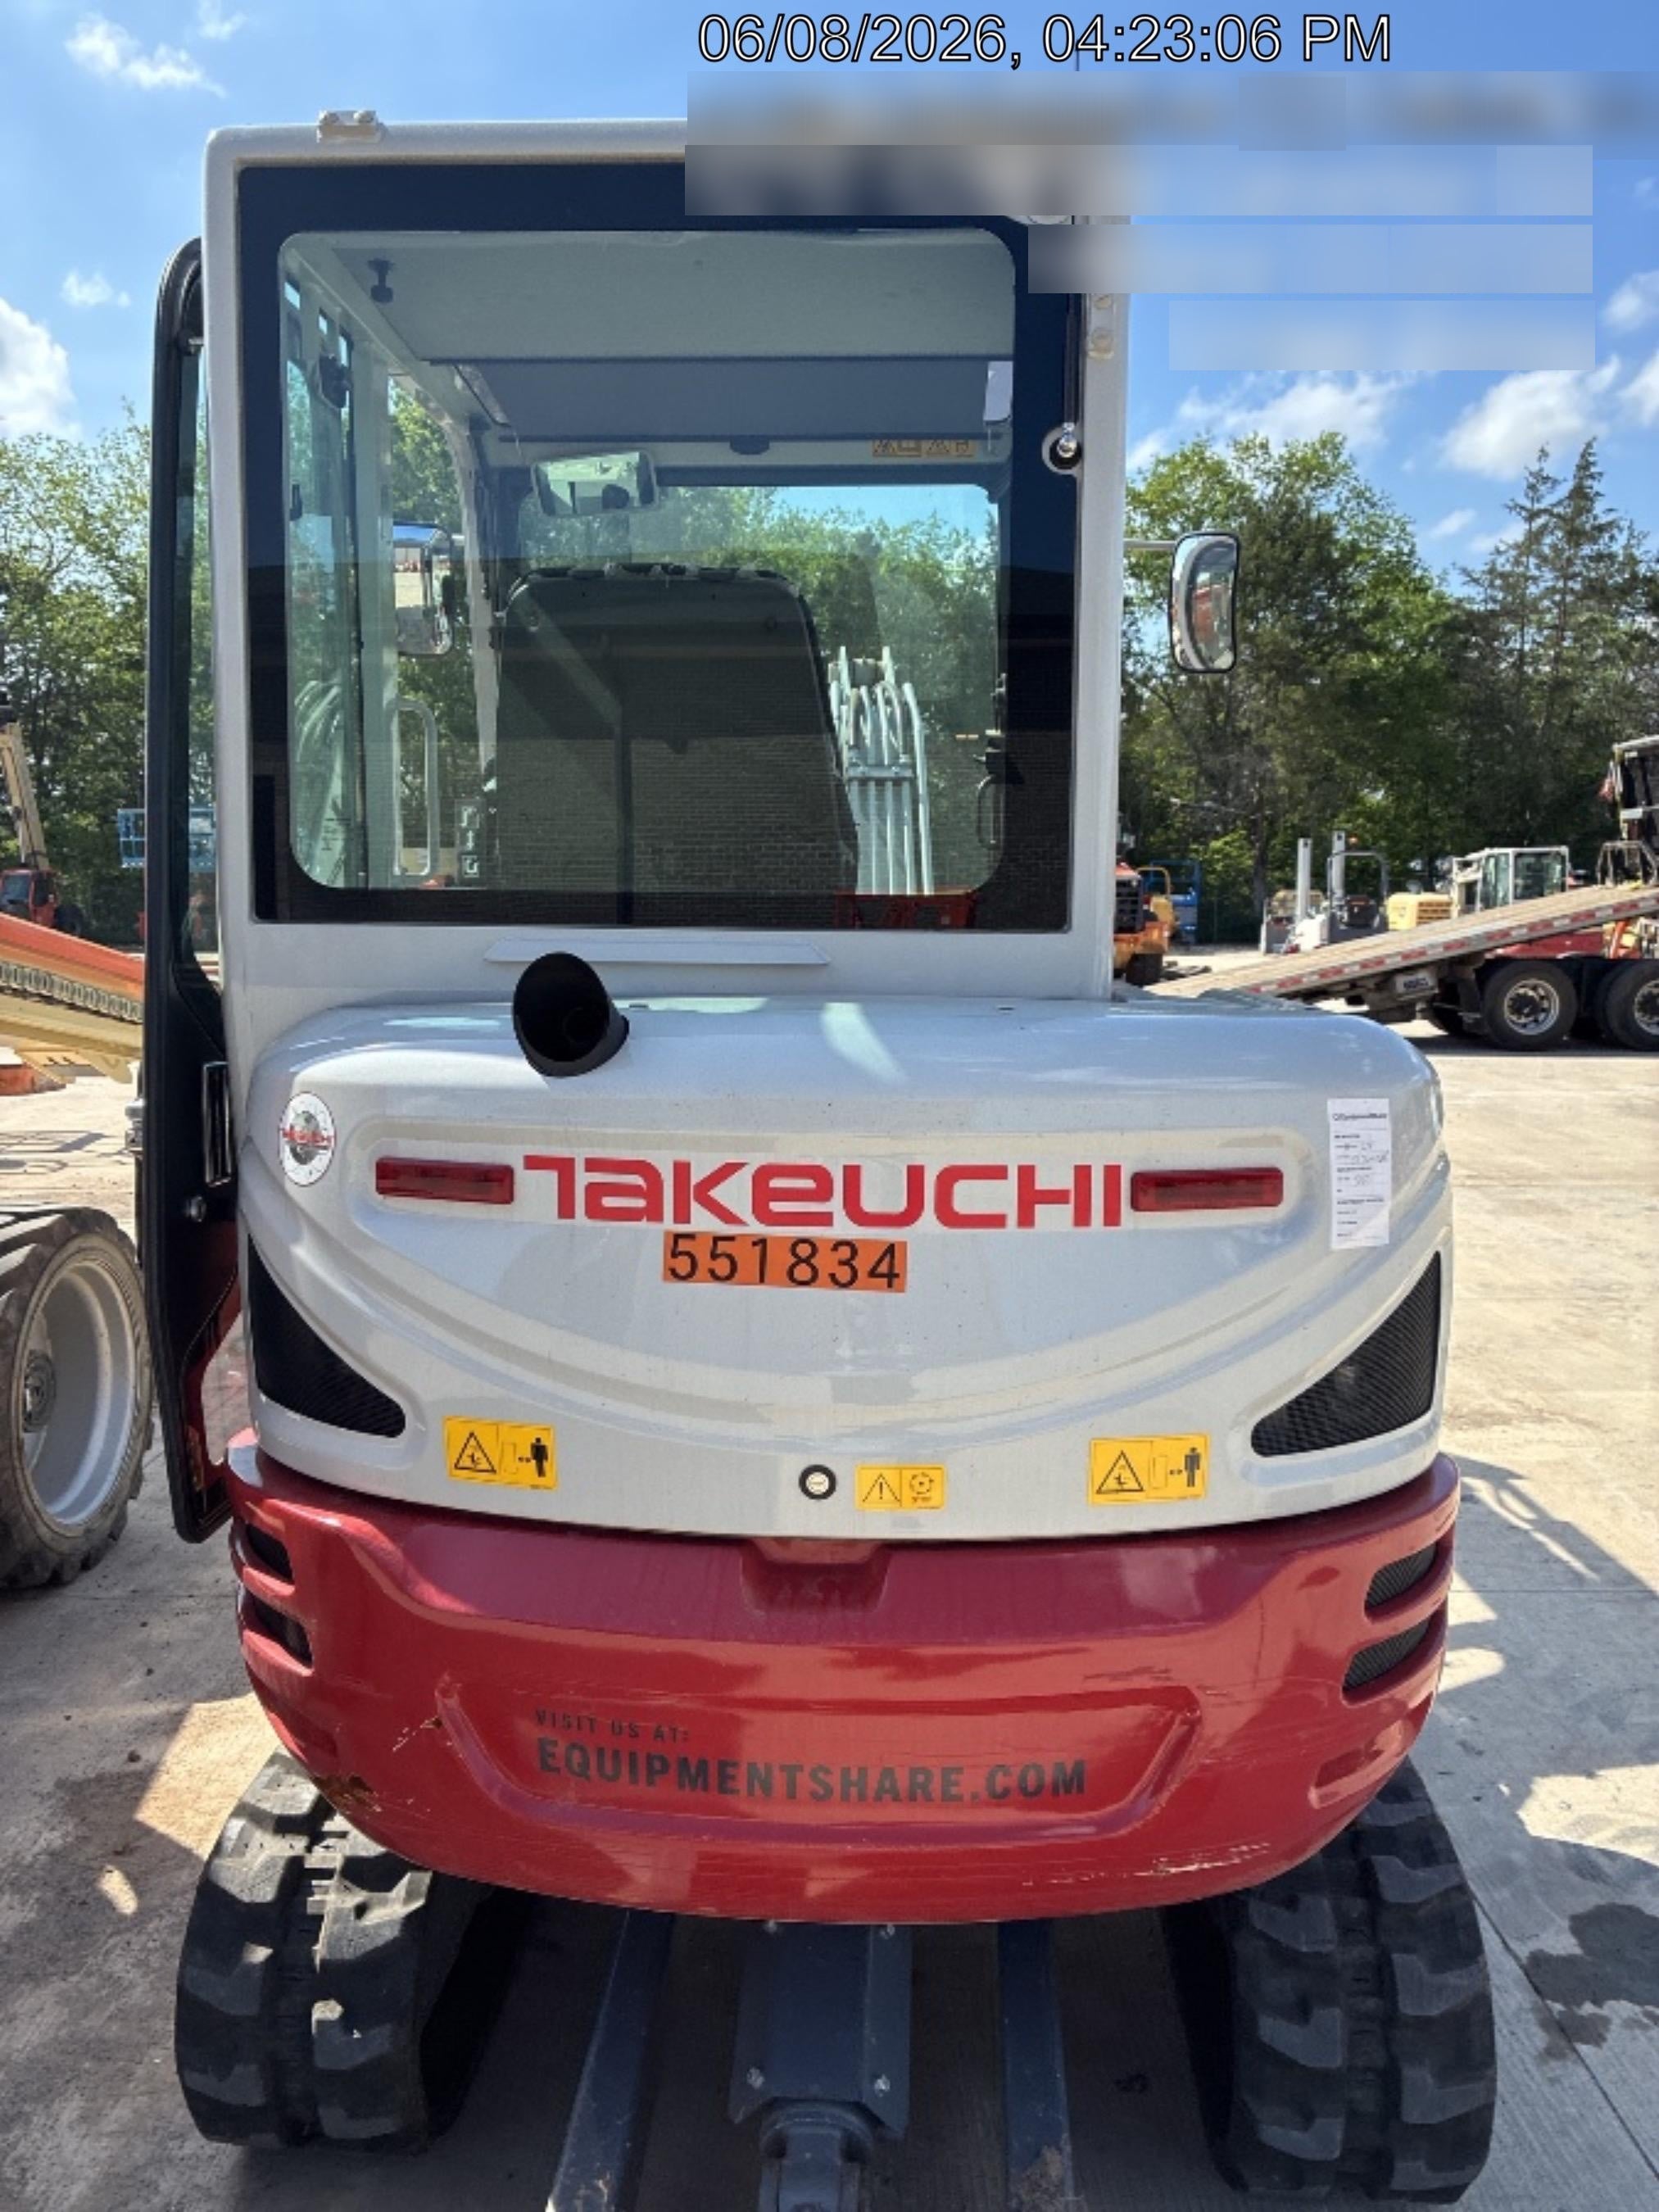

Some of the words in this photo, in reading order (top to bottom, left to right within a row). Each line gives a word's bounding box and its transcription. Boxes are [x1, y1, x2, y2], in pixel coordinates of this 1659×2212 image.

[667, 1233, 901, 1290] 551834
[535, 1709, 596, 1734] VISIT
[611, 1720, 640, 1738] US
[653, 1725, 689, 1744] AT:
[537, 1737, 1086, 1804] EQUIPMENTSHARE.COM
